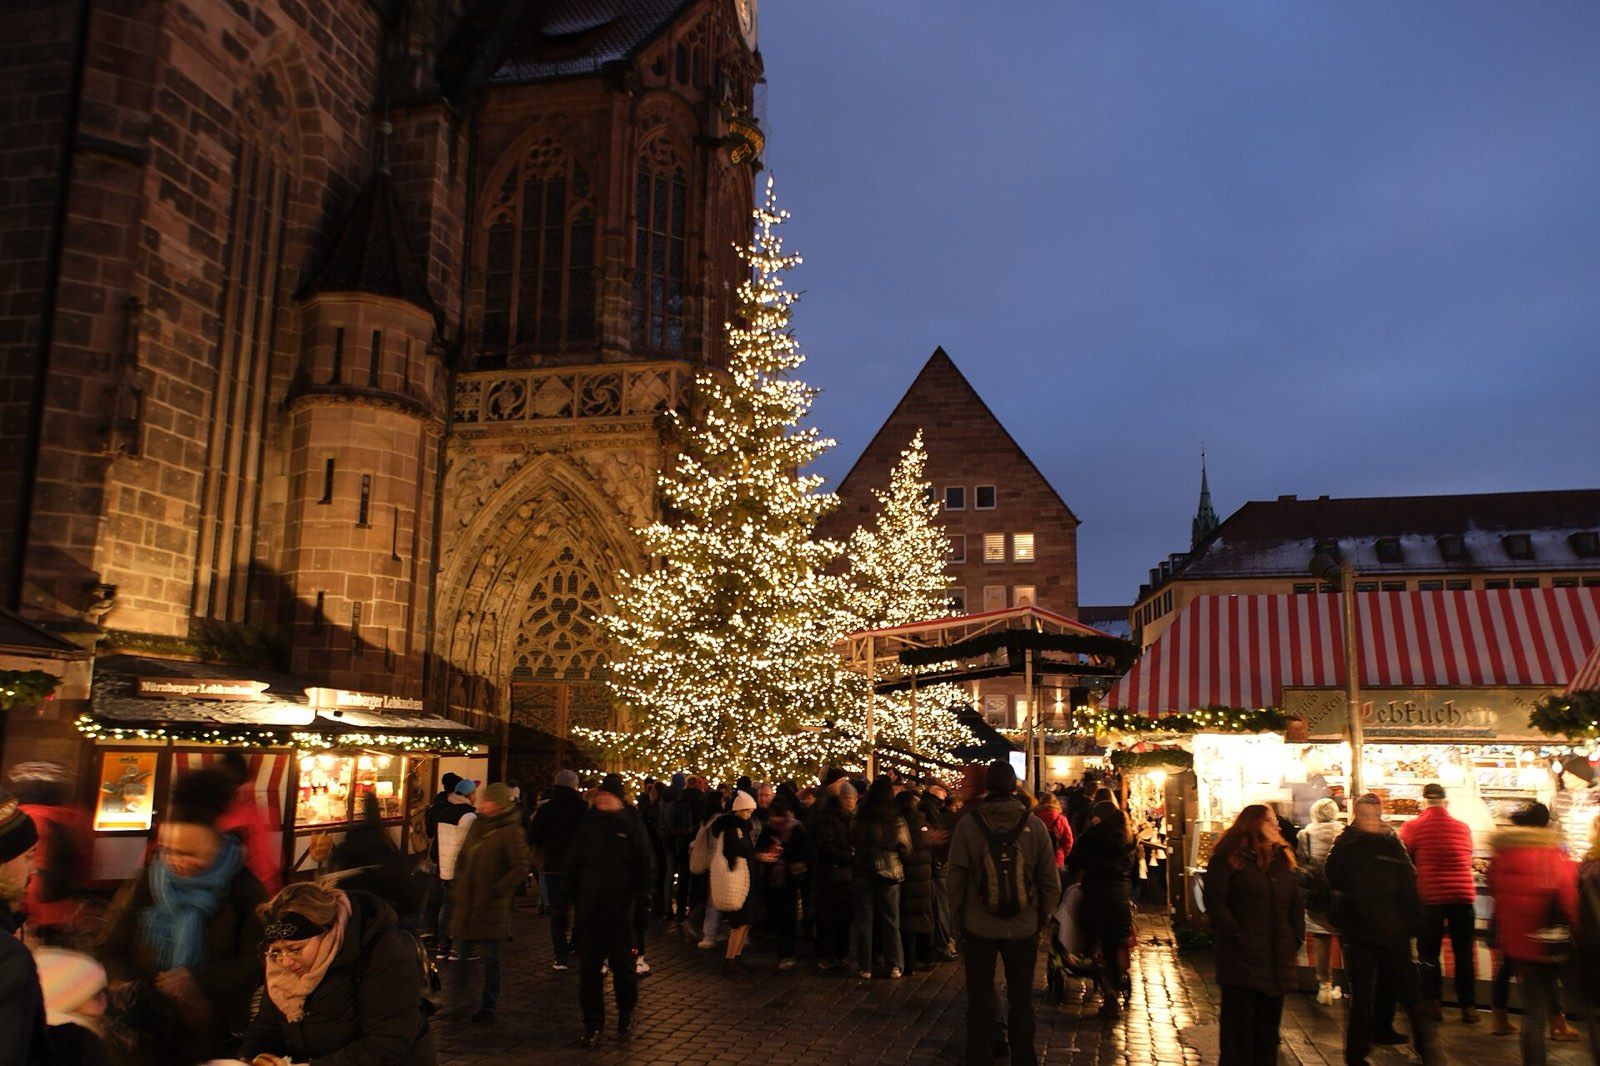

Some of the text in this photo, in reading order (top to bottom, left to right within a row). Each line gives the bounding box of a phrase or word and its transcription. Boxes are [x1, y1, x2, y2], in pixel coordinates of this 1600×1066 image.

[141, 681, 253, 697] Nürnberger Lebkuch
[338, 691, 424, 711] nberger Lebkuchen
[1359, 699, 1499, 726] Lebkuchen
